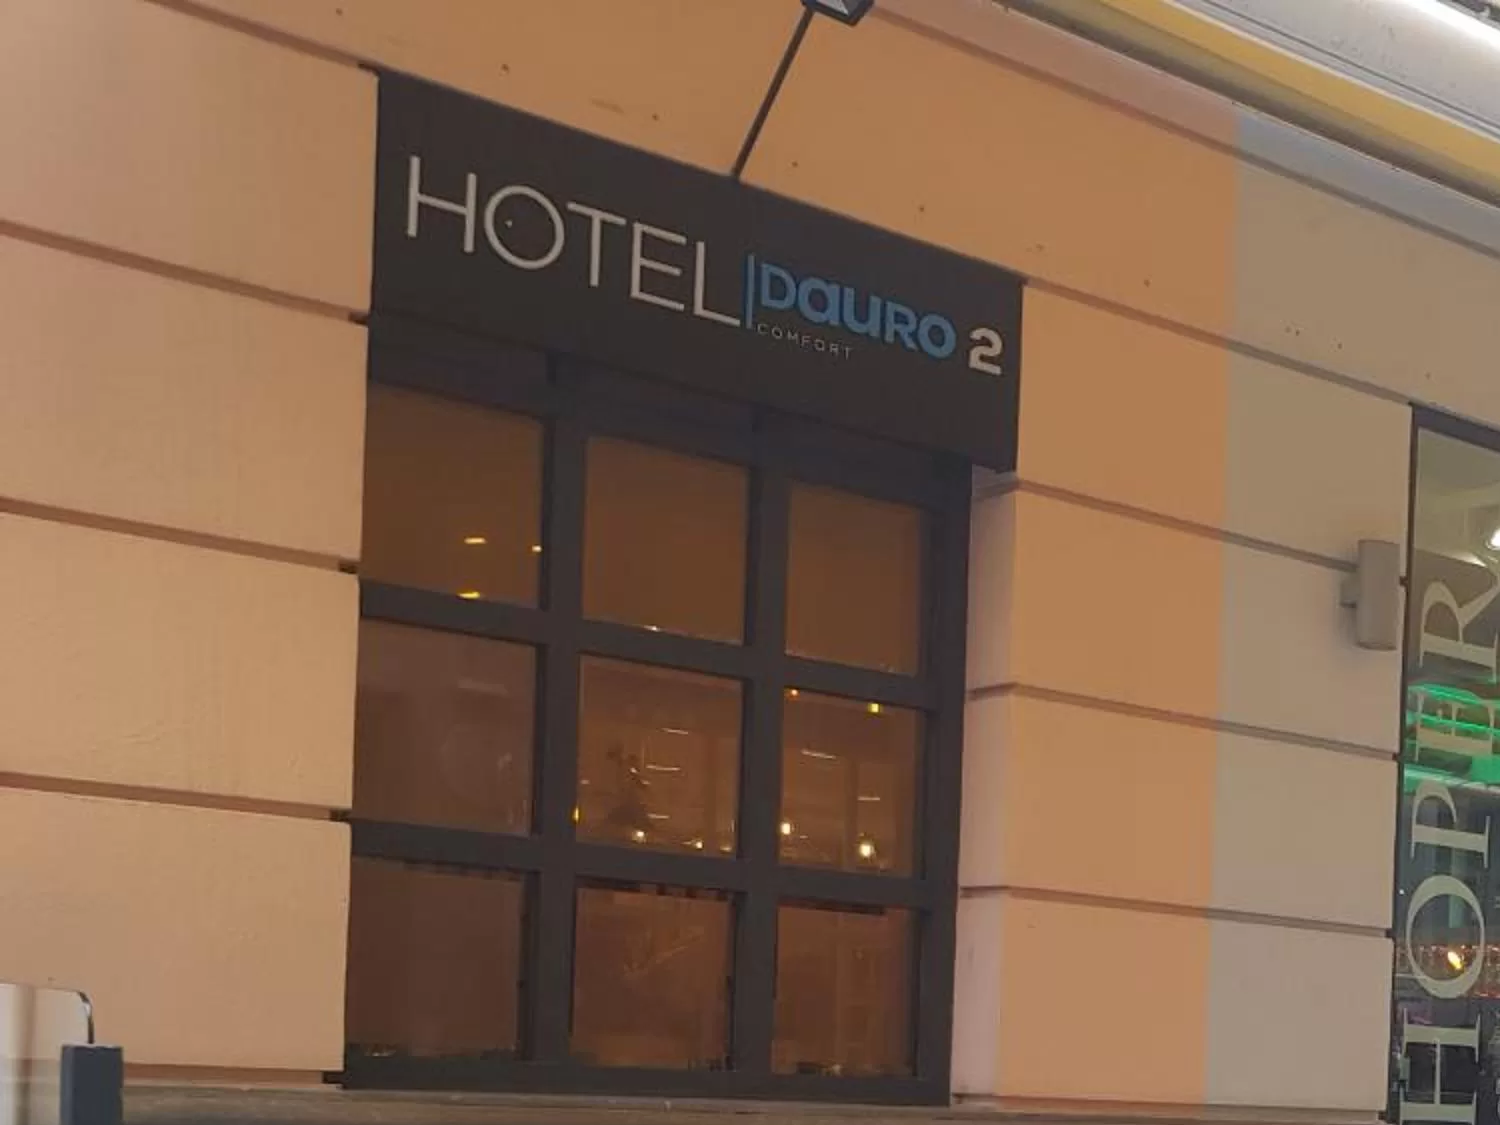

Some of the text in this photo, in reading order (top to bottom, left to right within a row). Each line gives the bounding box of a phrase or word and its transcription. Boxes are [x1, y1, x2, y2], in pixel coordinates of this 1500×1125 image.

[407, 154, 741, 326] HOTEL
[968, 327, 1003, 375] 2
[757, 322, 853, 361] COMFORT
